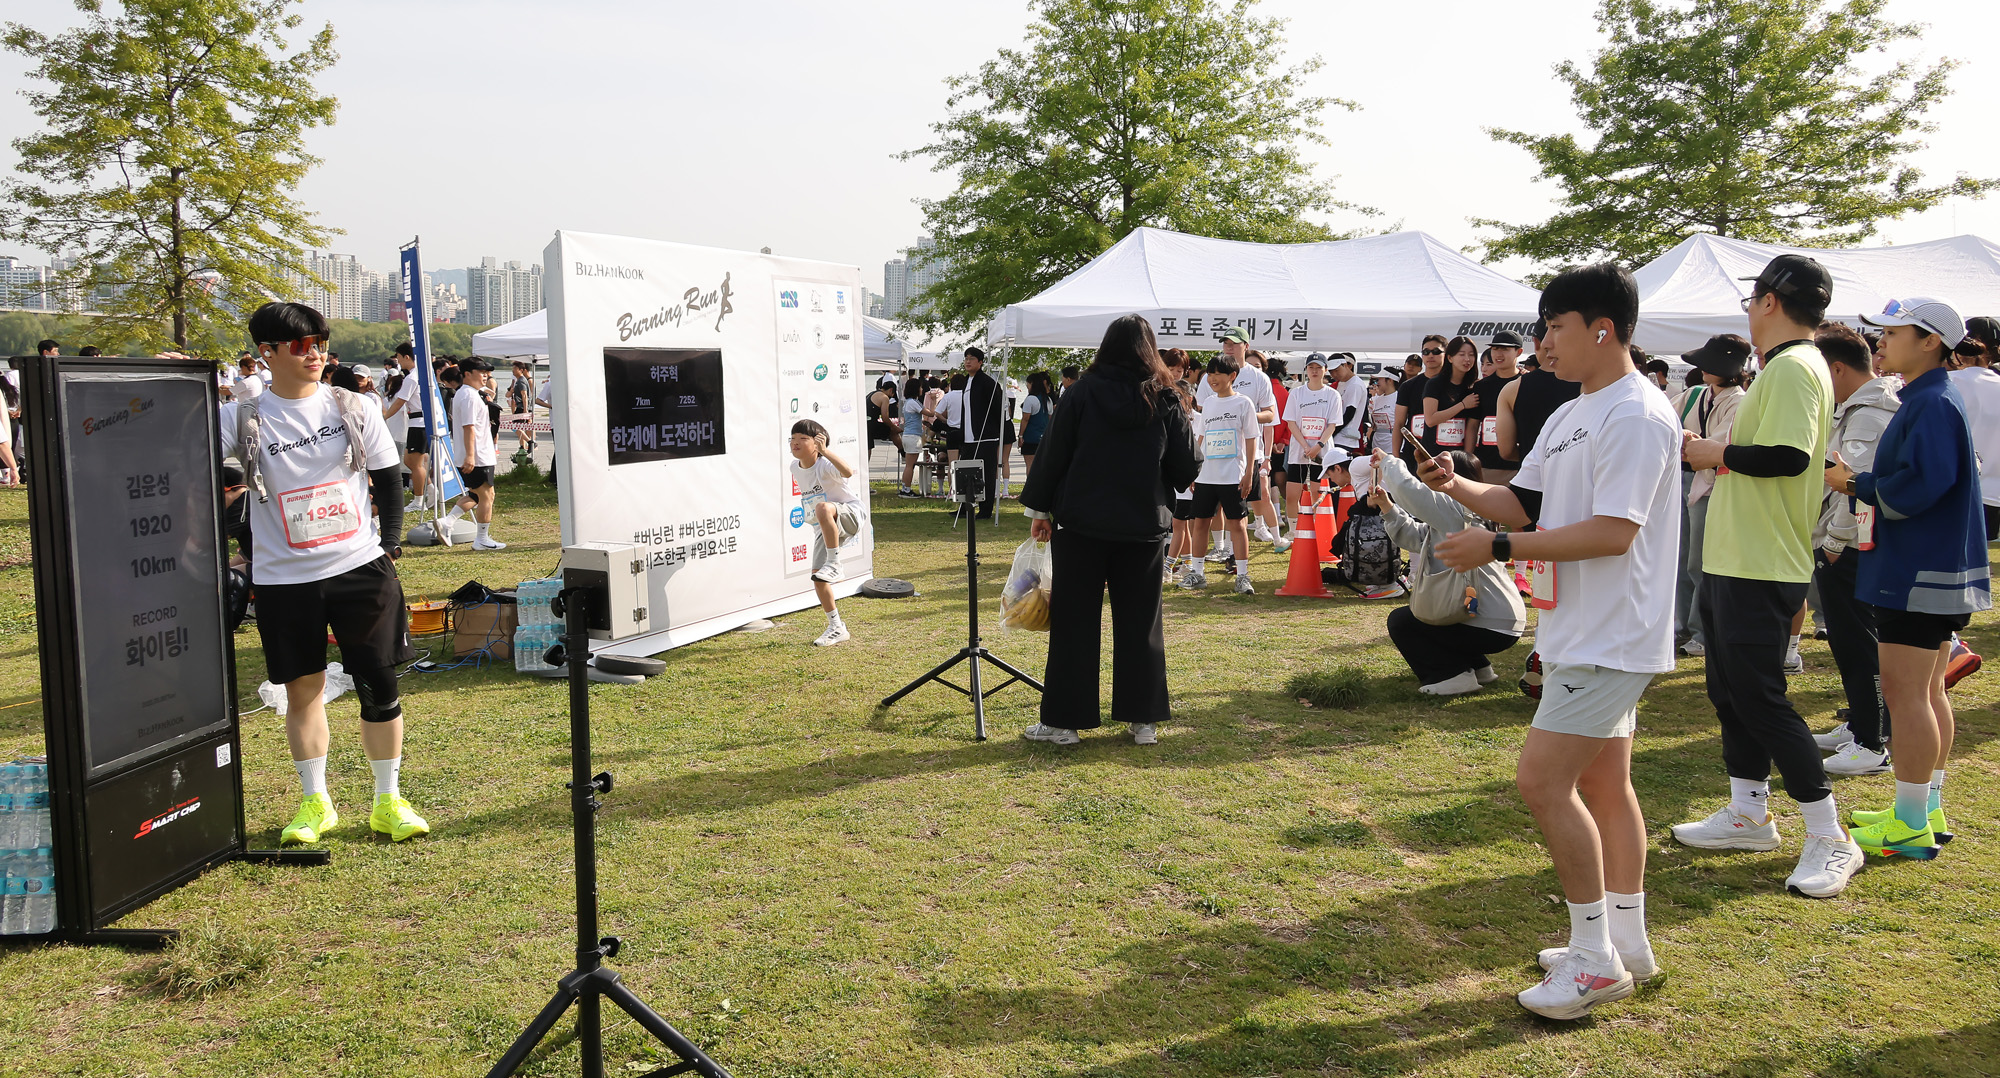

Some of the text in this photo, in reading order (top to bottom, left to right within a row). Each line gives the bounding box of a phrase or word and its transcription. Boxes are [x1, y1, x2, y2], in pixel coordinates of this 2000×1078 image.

[616, 304, 684, 342] Burning
[684, 286, 719, 317] Run
[650, 365, 679, 382] 허주혁
[635, 397, 651, 406] 7km
[679, 395, 696, 405] 7252
[83, 397, 154, 436] Burning Run
[268, 435, 318, 456] Burning
[318, 424, 345, 440] Run
[611, 420, 715, 452] 한계에 도전하다
[126, 473, 170, 499] 김윤성
[293, 502, 348, 522] M 1920
[130, 514, 172, 538] 1920
[634, 515, 741, 546] #버닝런 #버닝런2025
[691, 536, 738, 560] #일요신문
[131, 556, 176, 578] 10km
[133, 606, 177, 627] RECORD
[126, 627, 189, 667] 화이팅!
[133, 811, 180, 839] SMART
[180, 801, 201, 817] CHIP
